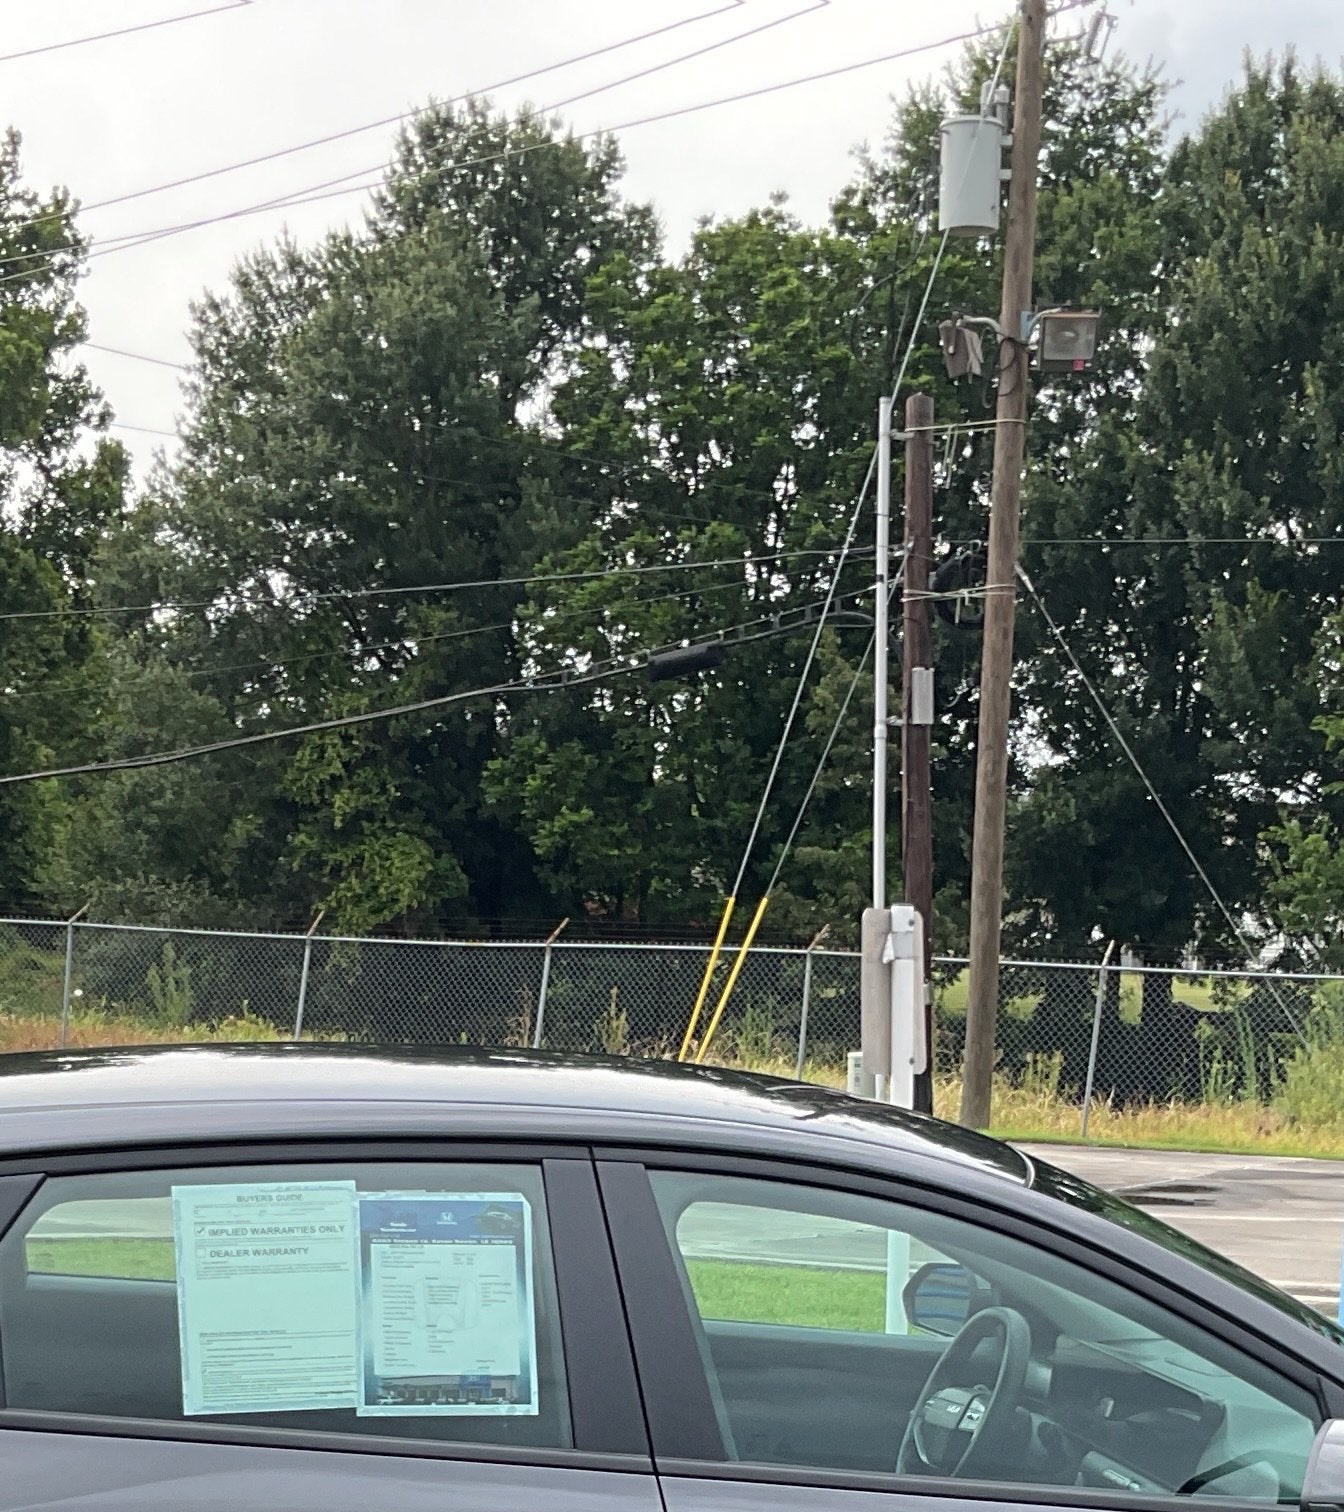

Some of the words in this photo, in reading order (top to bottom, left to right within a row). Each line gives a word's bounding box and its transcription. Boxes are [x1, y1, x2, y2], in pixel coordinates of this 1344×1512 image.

[236, 1194, 273, 1203] BUYERS
[276, 1193, 303, 1202] GUIDE
[208, 1227, 248, 1237] IMPLIED
[250, 1225, 316, 1236] WARRANTIES
[318, 1224, 345, 1234] ONLY
[209, 1249, 249, 1258] DEALER
[252, 1247, 309, 1257] WARRANTY
